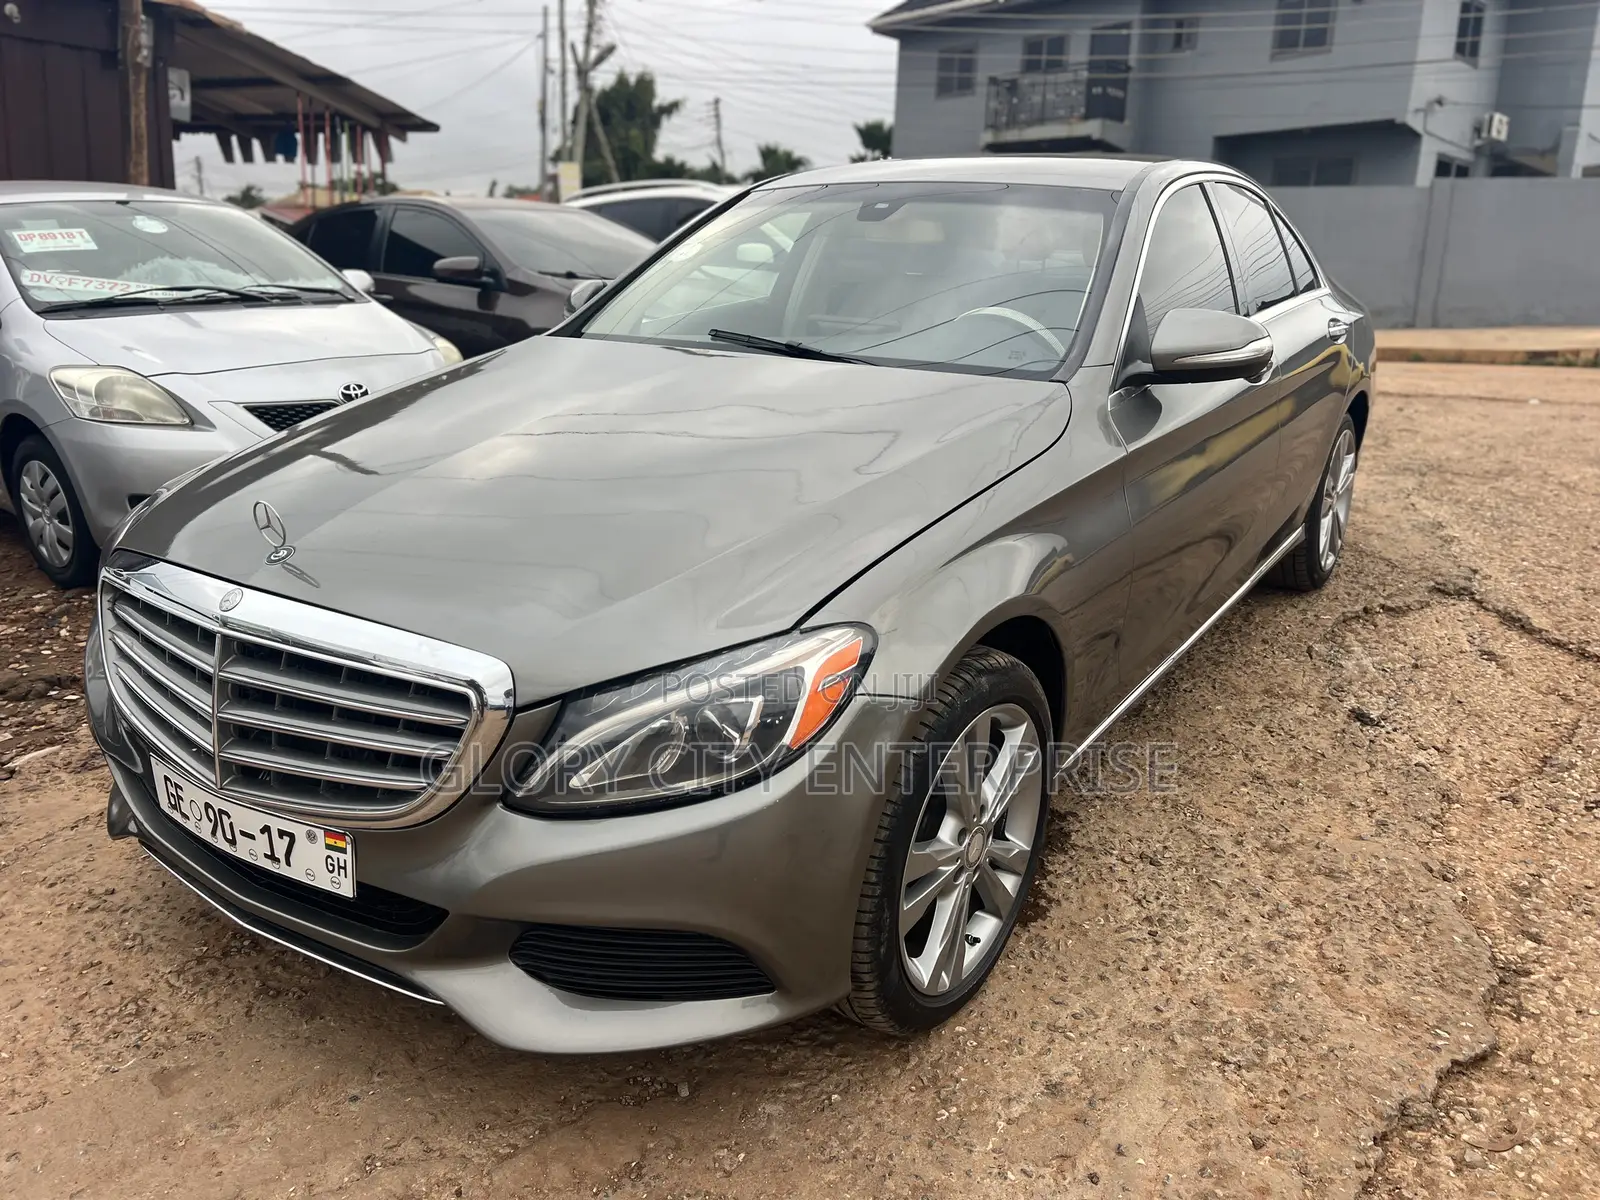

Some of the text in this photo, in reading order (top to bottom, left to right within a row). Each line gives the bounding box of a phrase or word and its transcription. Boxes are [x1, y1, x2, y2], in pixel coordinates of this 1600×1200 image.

[29, 273, 54, 284] DV
[164, 775, 296, 867] GE 90-17
[325, 854, 348, 879] GH
